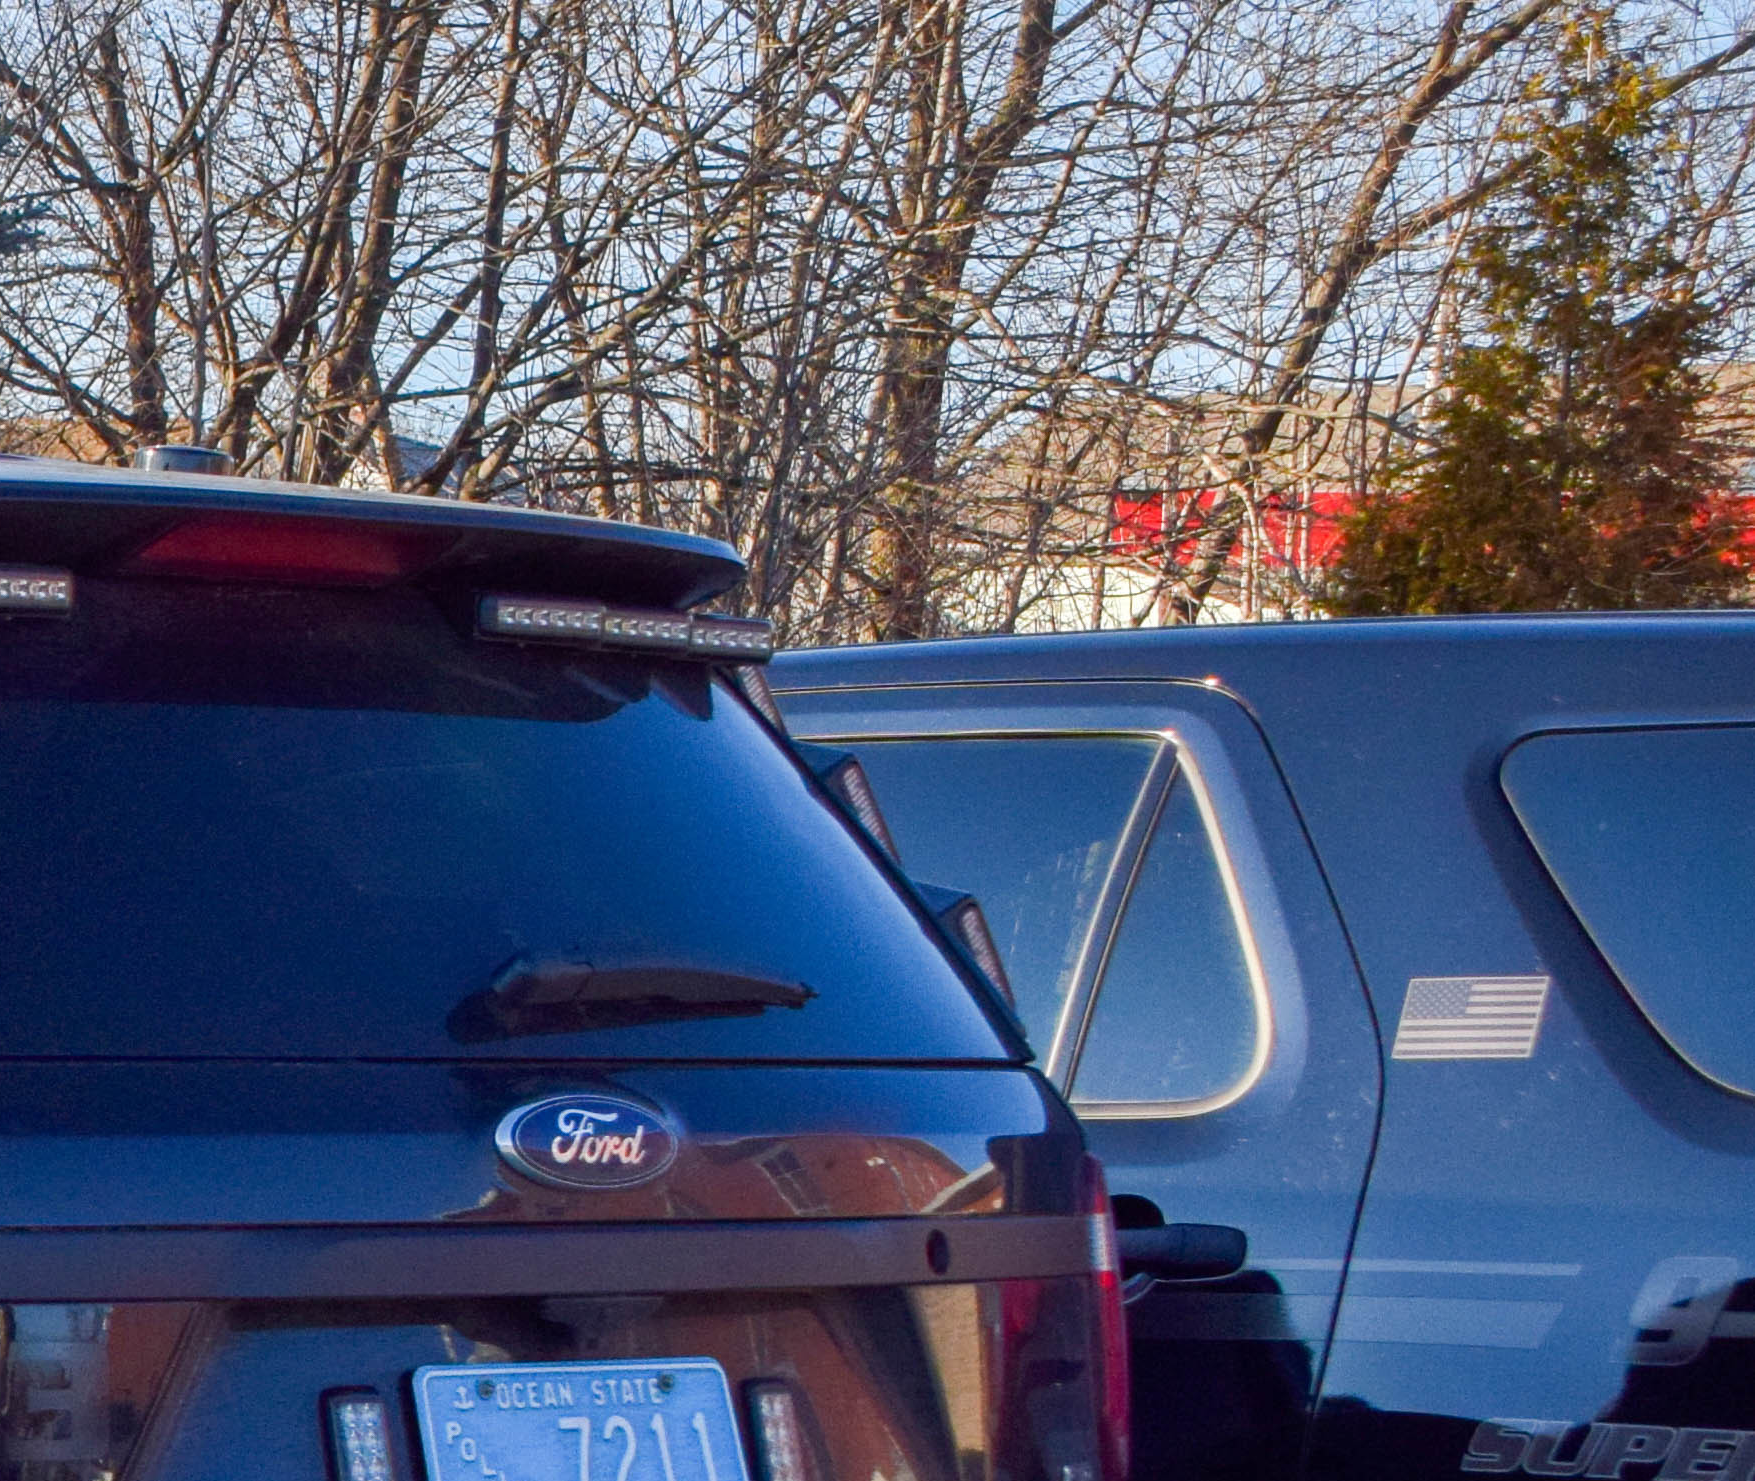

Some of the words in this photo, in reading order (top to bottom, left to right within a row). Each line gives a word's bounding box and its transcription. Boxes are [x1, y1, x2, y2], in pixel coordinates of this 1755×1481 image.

[551, 1108, 646, 1163] Ford
[495, 1380, 574, 1410] OCEAN
[592, 1377, 663, 1405] STATE
